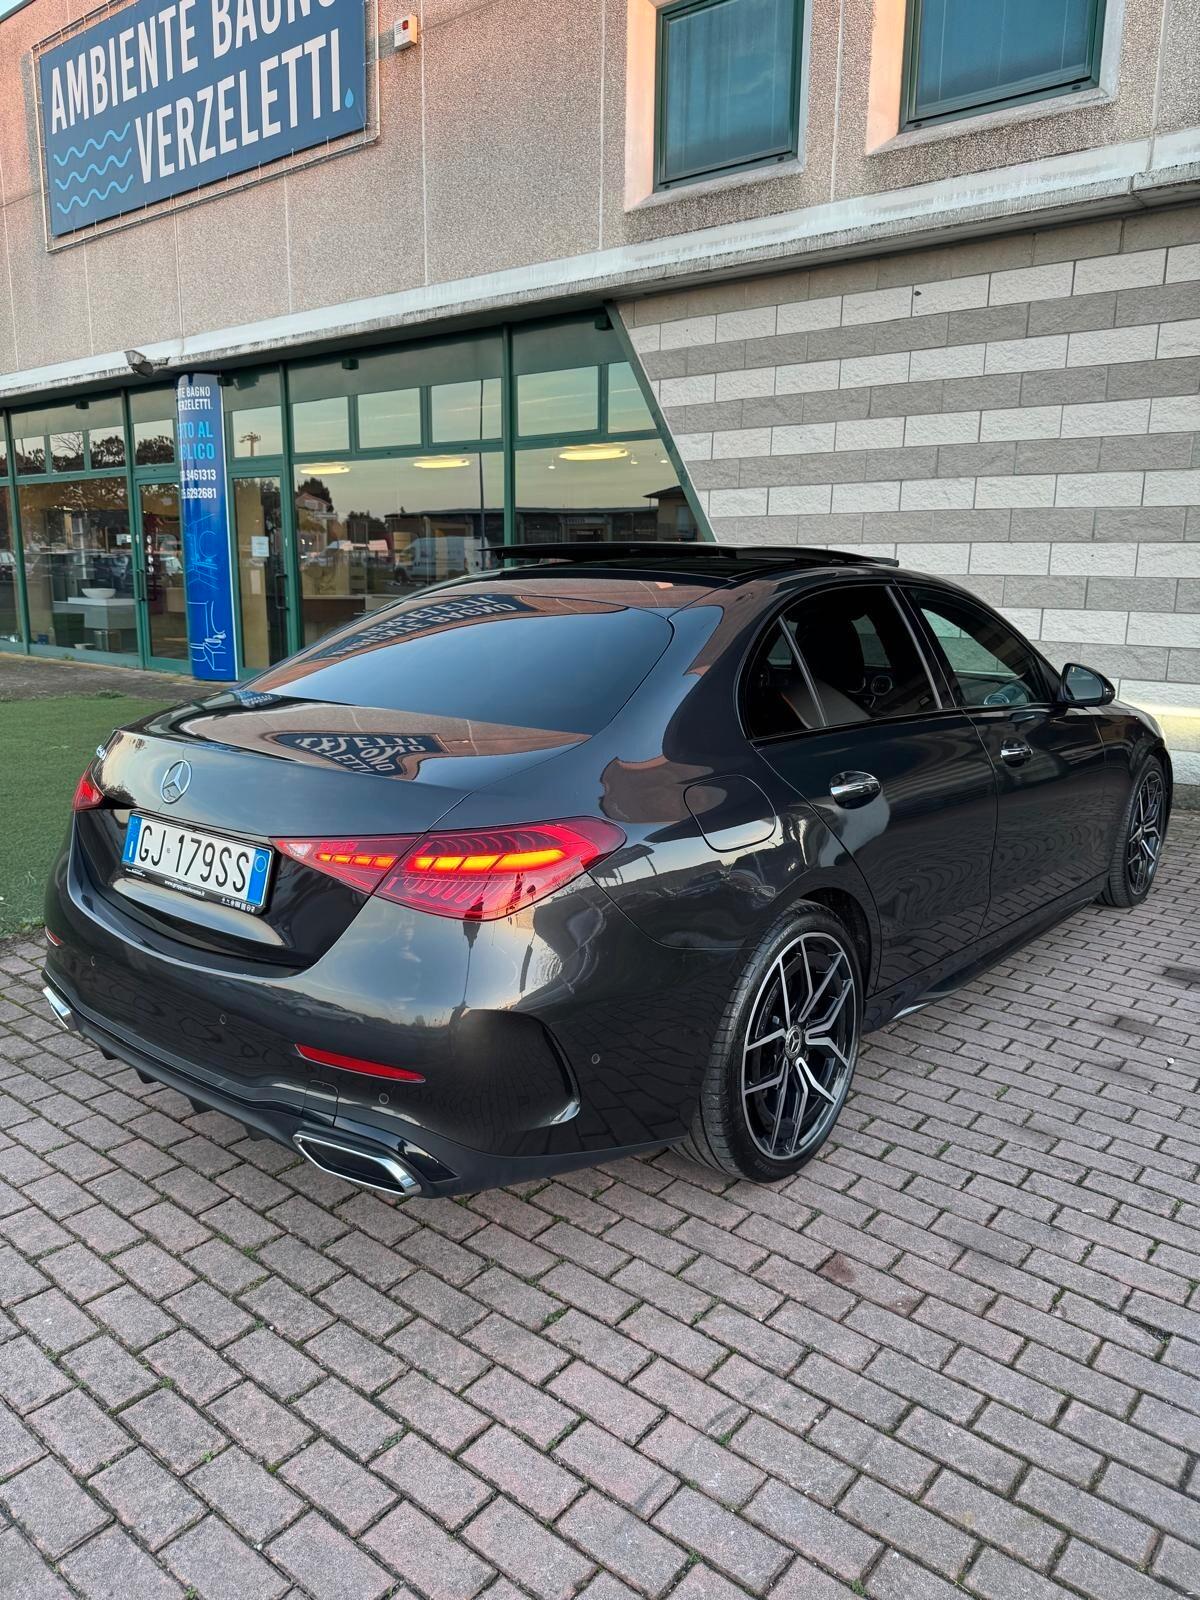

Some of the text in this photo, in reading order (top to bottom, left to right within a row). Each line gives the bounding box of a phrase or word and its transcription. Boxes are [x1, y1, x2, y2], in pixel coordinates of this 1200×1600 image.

[50, 0, 200, 135] AMBIENTE
[186, 386, 211, 398] BAGNO
[199, 421, 214, 438] AL
